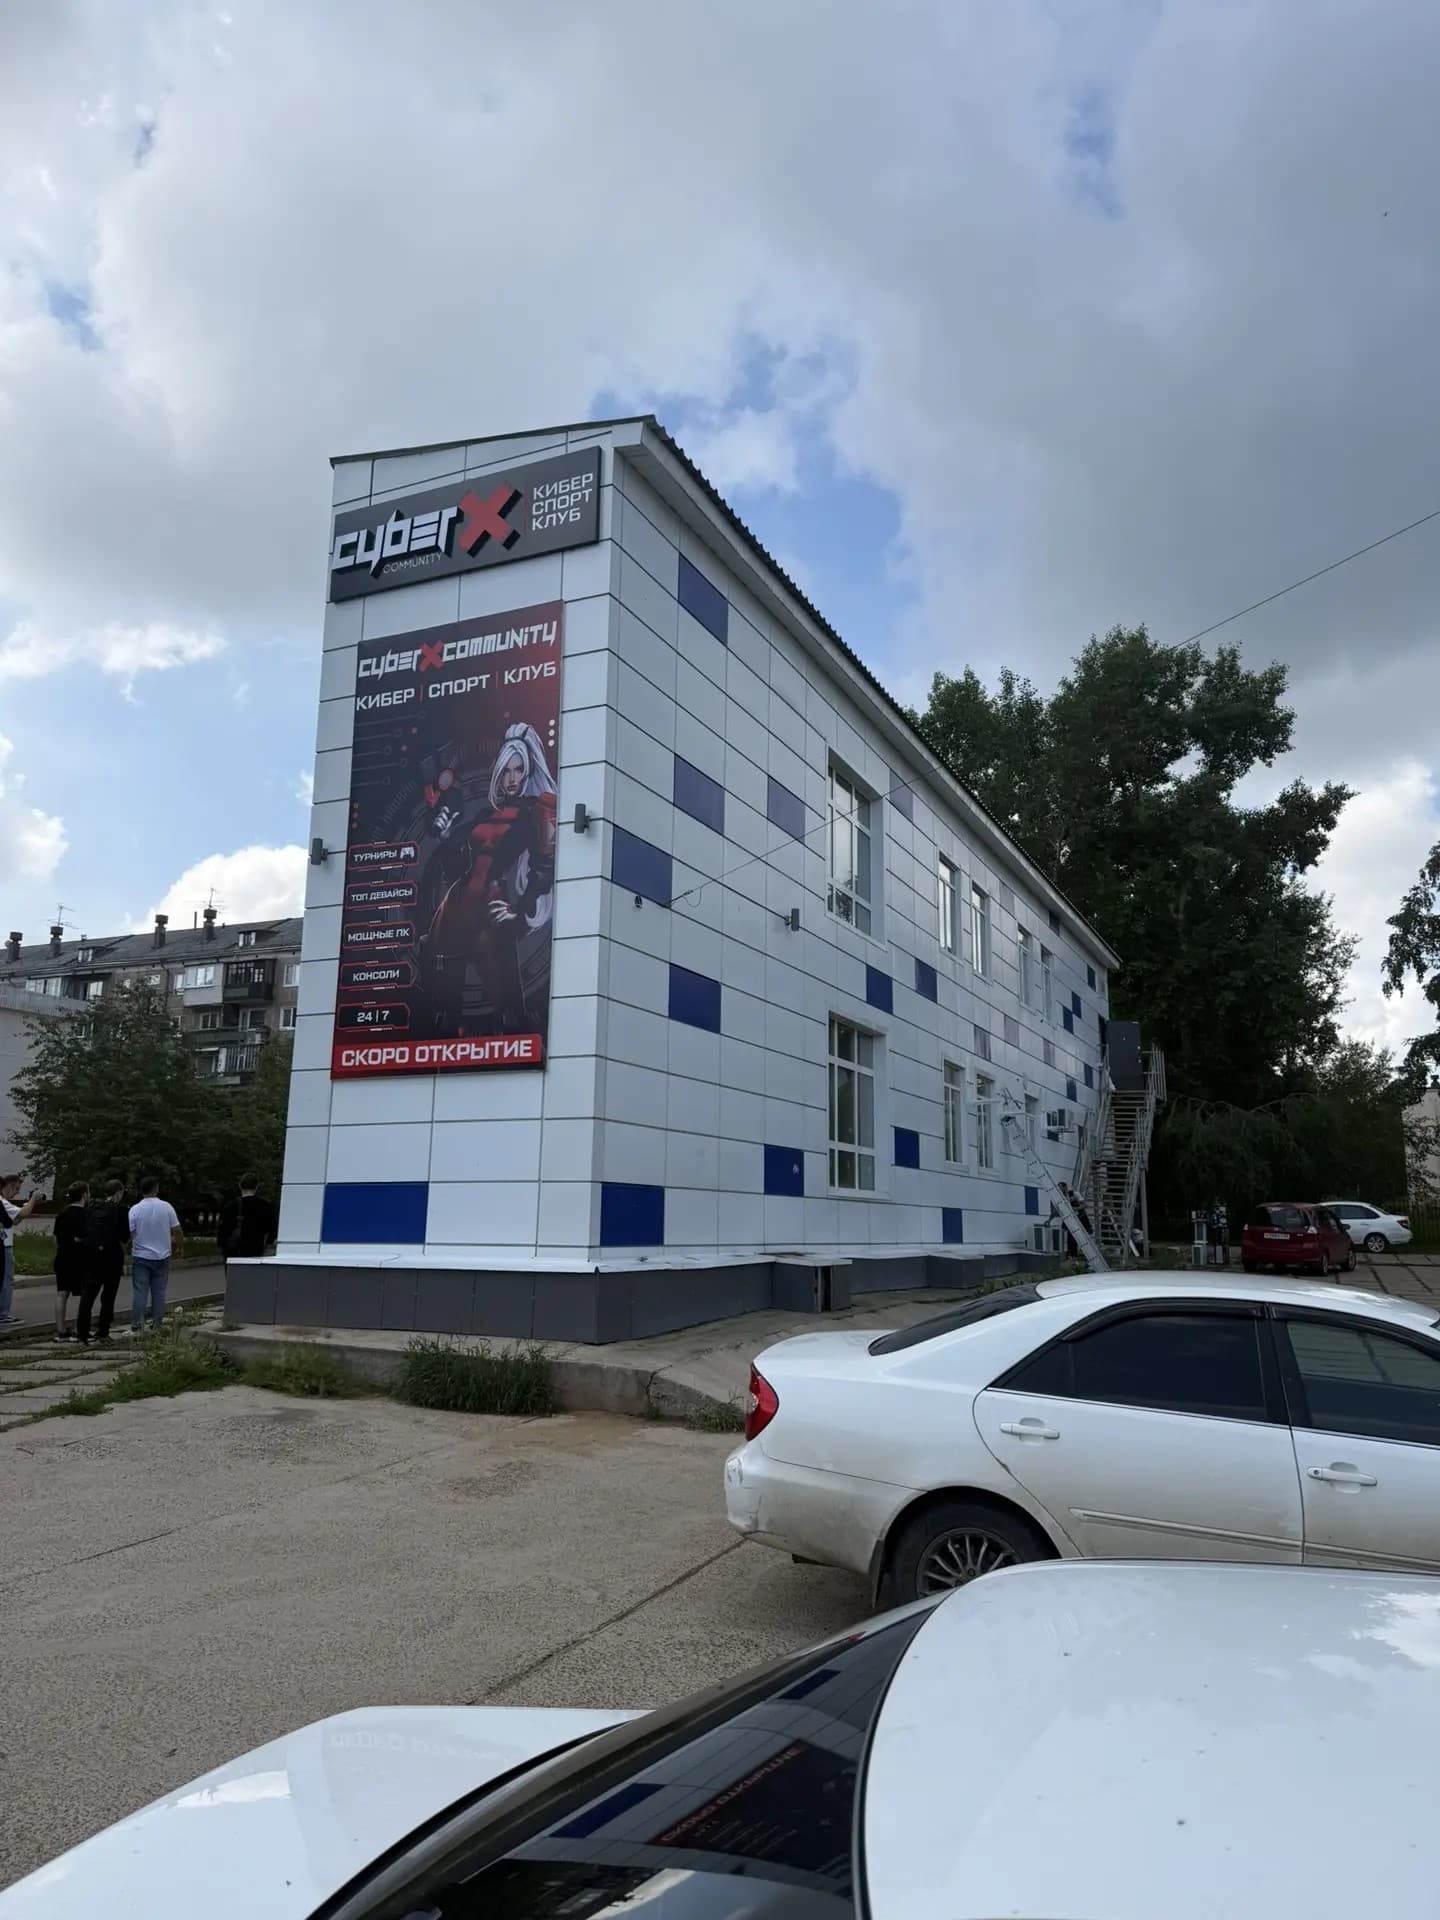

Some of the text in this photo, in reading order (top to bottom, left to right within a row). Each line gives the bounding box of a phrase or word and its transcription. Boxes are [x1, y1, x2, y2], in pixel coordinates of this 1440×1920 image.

[533, 473, 593, 500] КИБЕР
[532, 489, 593, 514] СПОРТ
[532, 507, 581, 531] КЛУБ
[383, 552, 442, 574] COMMUNITY
[356, 661, 556, 710] КИБЕР СПОРТ КЛУБ
[353, 850, 397, 862] ТУРНИРЫ
[351, 888, 413, 901] ТОП ДЕВАЙСЫ
[348, 928, 410, 942] МОЩНЫЕ ПК
[352, 969, 400, 982] КОНСОЛИ
[341, 1039, 532, 1067] СКОРО ОТКРЫТИЕ
